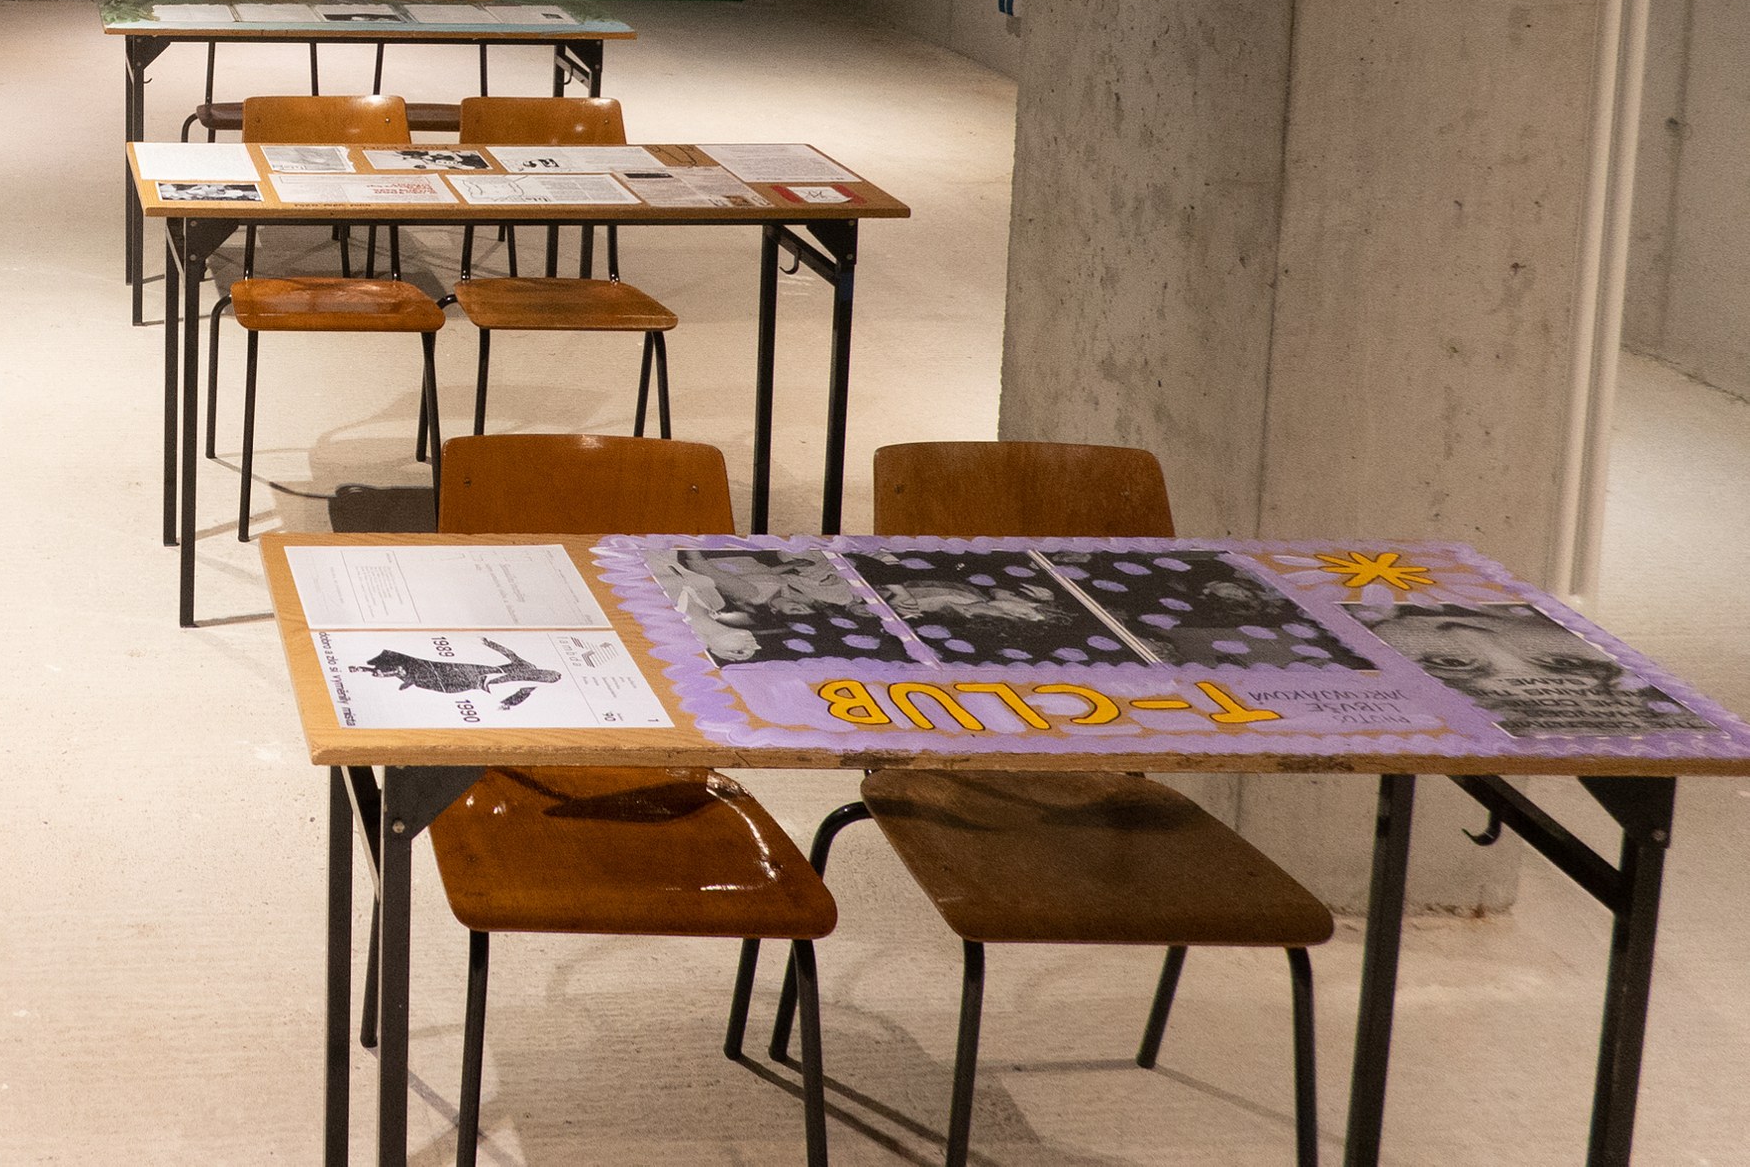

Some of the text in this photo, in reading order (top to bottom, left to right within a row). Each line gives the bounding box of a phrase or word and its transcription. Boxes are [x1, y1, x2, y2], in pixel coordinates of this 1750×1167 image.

[318, 632, 339, 649] dobro
[430, 636, 456, 658] 1989
[325, 655, 347, 665] zlo
[556, 636, 582, 667] lambda
[1497, 678, 1587, 686] SAME.
[454, 699, 481, 723] 1990
[817, 678, 1283, 732] T-CLUB
[1585, 699, 1637, 708] THE
[1644, 720, 1702, 729] THE
